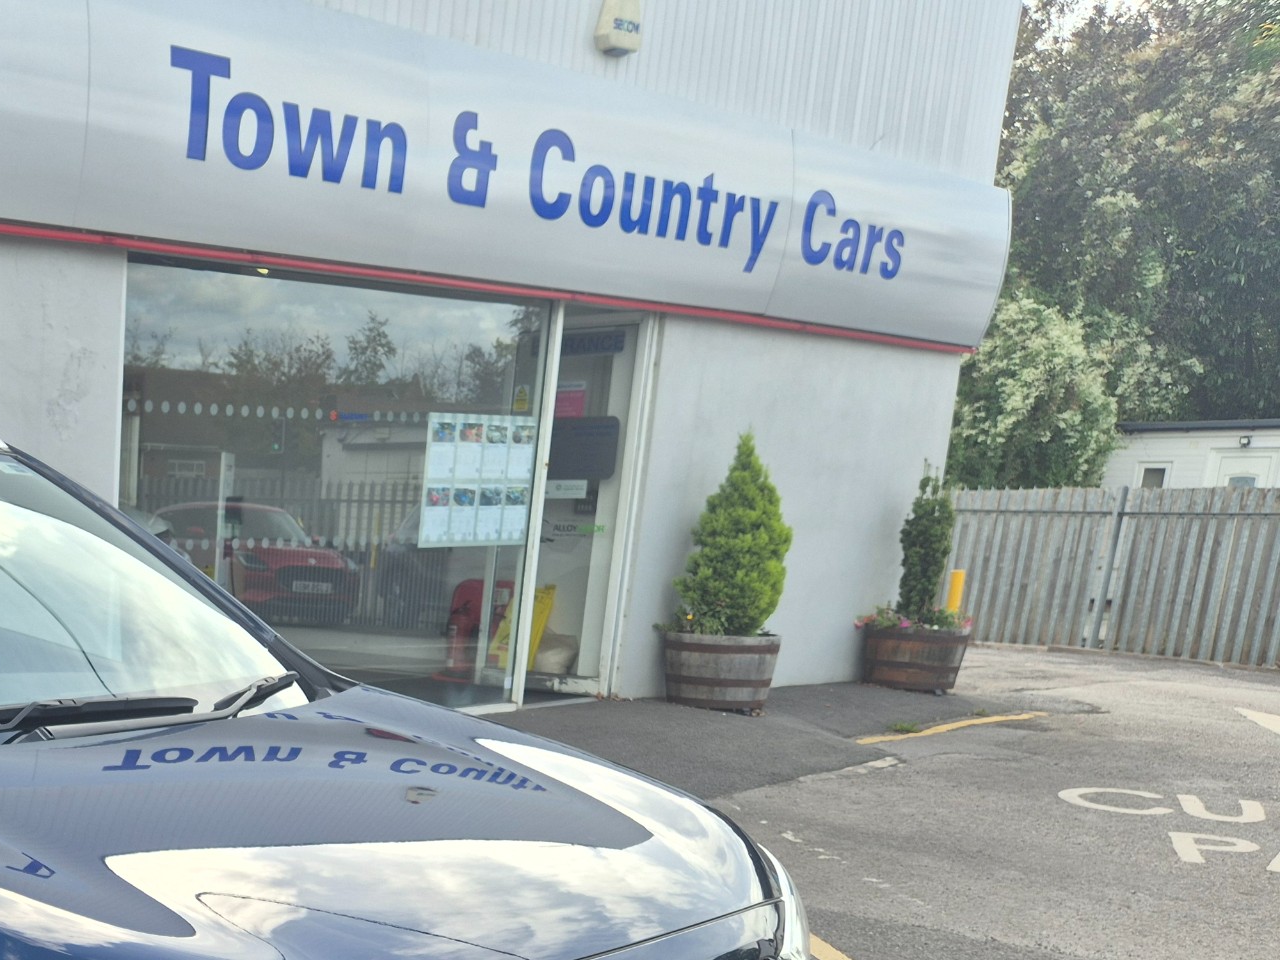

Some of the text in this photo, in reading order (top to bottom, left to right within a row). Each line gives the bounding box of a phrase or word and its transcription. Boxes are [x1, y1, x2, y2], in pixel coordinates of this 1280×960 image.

[170, 46, 905, 280] Town & Country Cars
